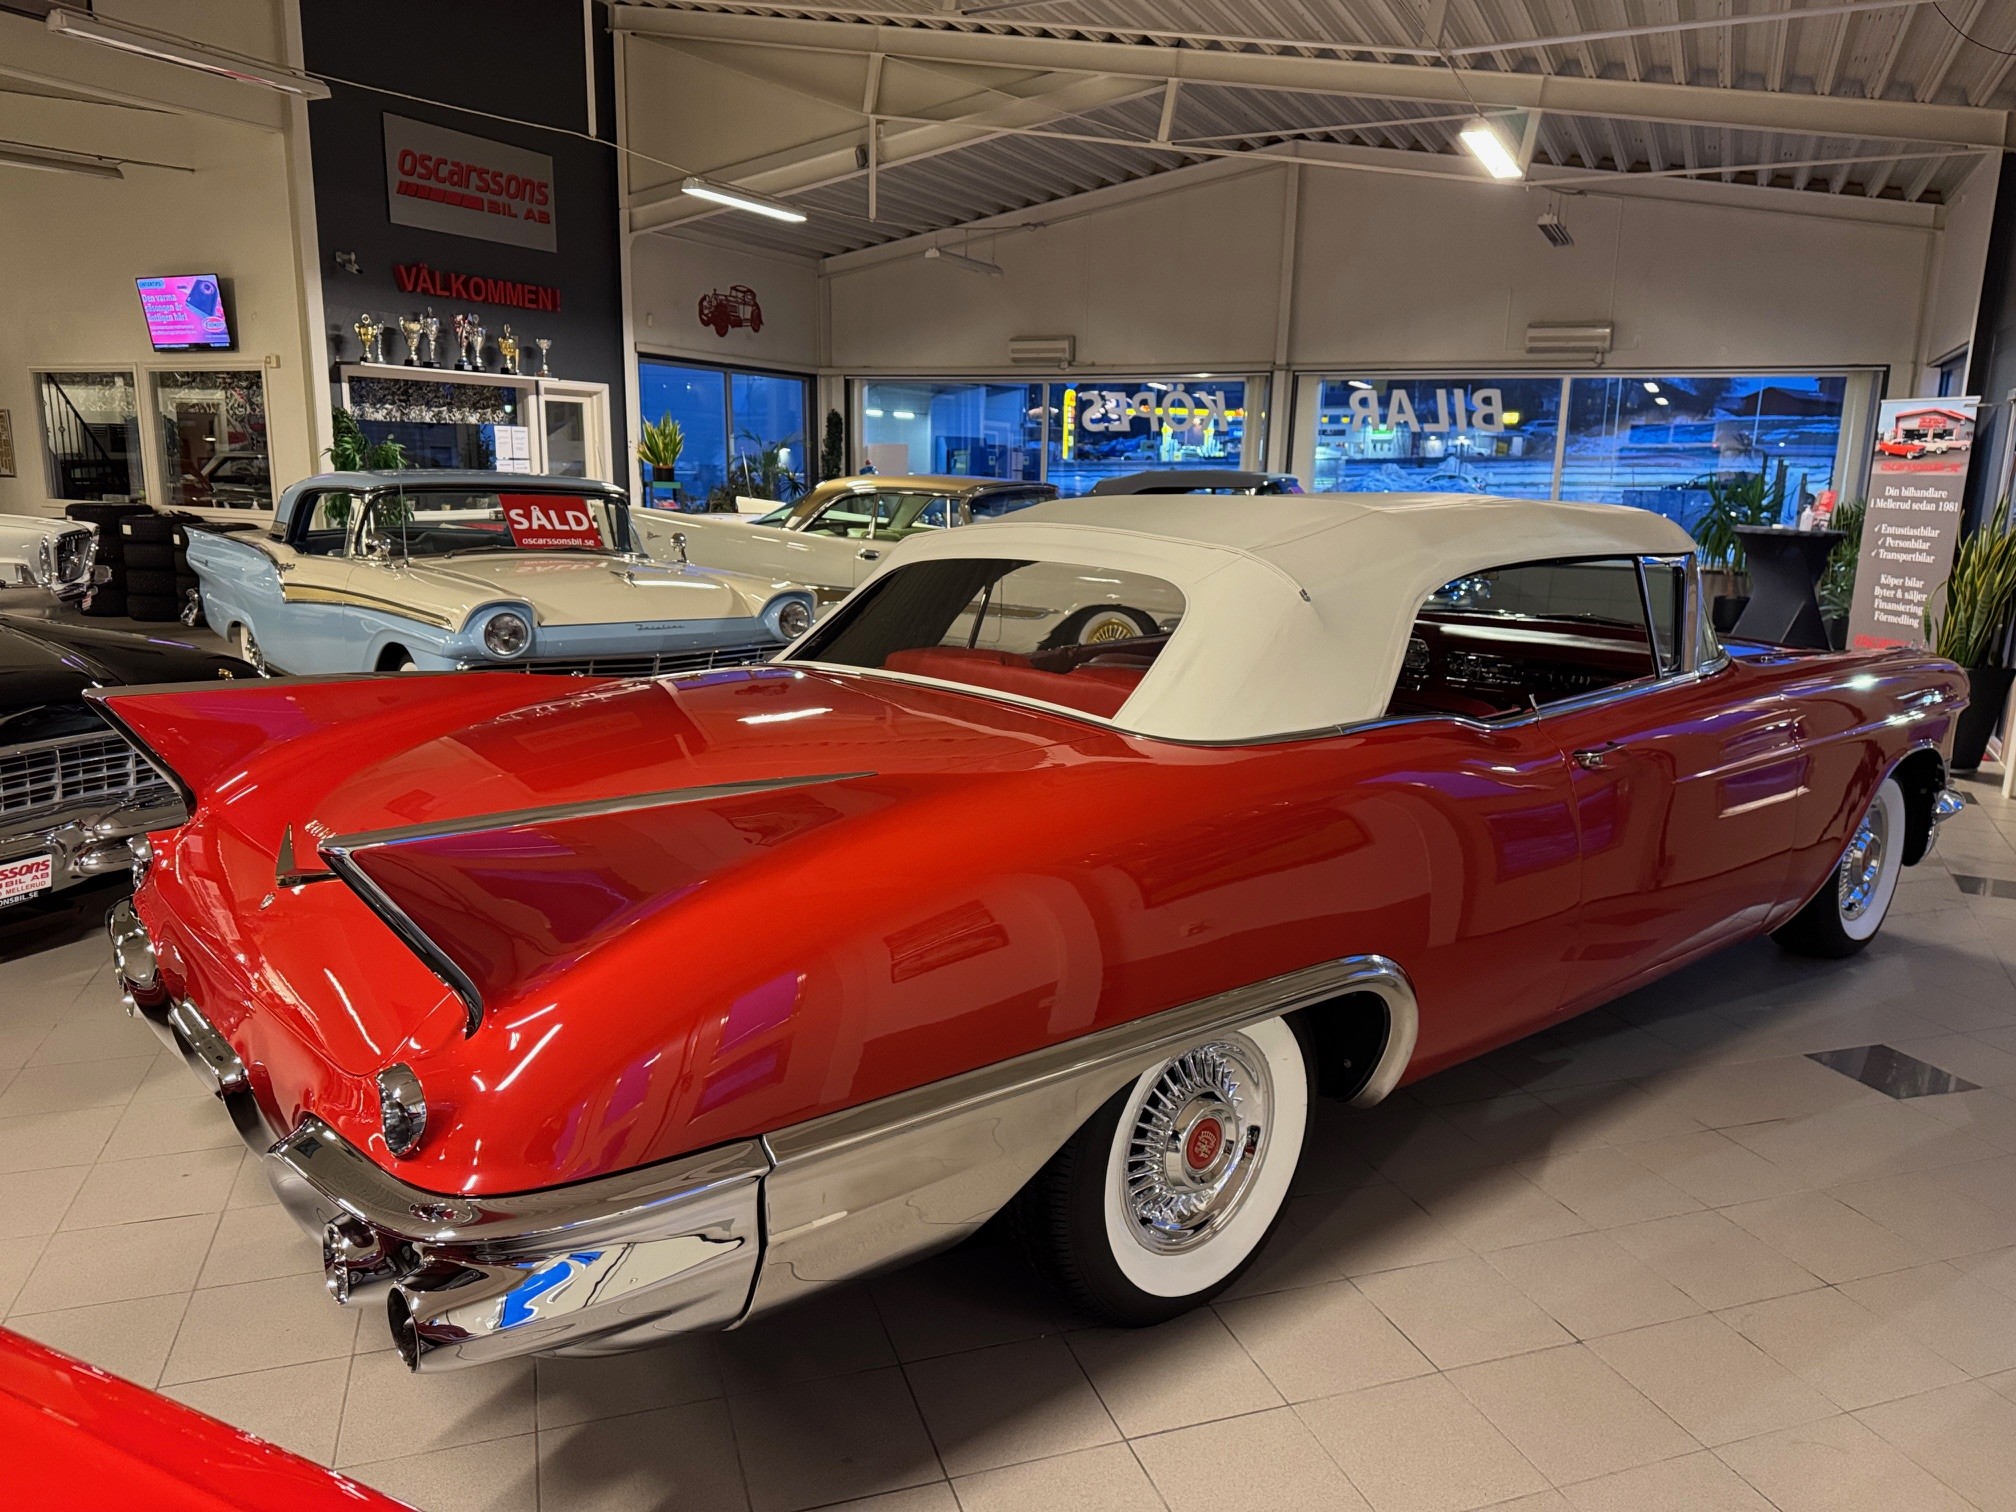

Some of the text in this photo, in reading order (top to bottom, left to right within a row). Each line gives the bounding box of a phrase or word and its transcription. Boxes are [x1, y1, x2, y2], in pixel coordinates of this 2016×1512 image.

[397, 148, 549, 205] oscarssons
[487, 199, 551, 224] BIL AB
[396, 262, 561, 312] VÄLKOMMEN!
[1885, 486, 1948, 498] Din bilhandlare
[1876, 499, 1911, 510] Mellerud
[1912, 500, 1936, 511] sedan
[1938, 501, 1959, 512] 1981
[509, 505, 590, 531] SÅLD
[522, 537, 595, 546] oscarssonsbil.se
[1885, 537, 1931, 550] Personbilar
[1879, 548, 1935, 564] Transportbilar
[1880, 574, 1924, 588] Köper bilar
[1874, 586, 1928, 603] Byter & säljer
[1874, 598, 1924, 616] Finansiering
[1874, 610, 1920, 629] Förmedling
[5, 872, 49, 888] BIL AB
[6, 880, 46, 895] MELLERUD
